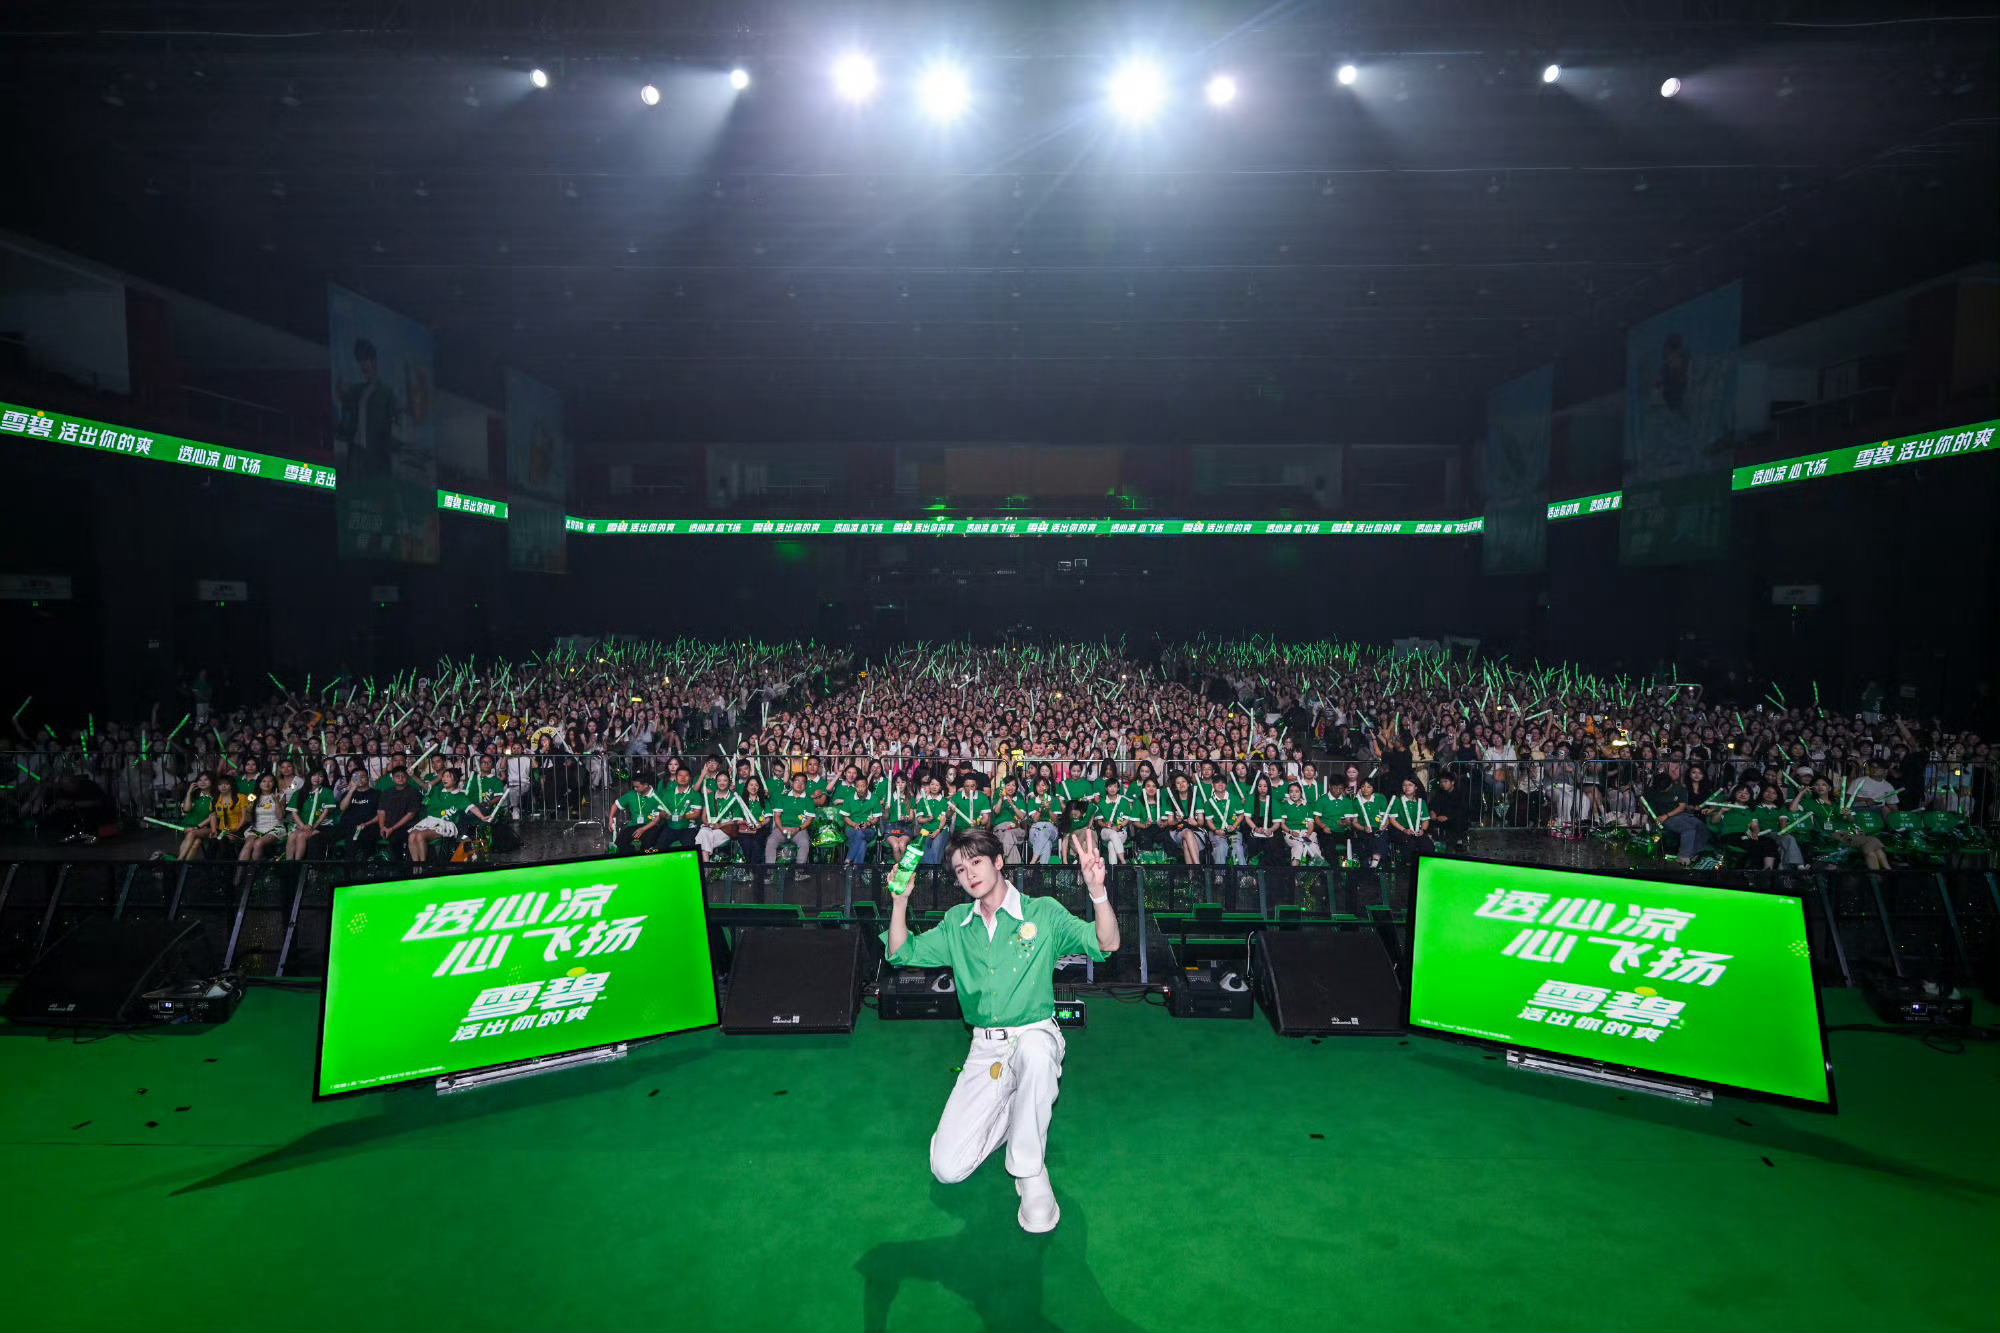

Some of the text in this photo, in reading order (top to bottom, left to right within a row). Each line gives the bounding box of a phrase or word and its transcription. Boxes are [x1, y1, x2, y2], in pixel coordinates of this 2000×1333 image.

[0, 411, 153, 454] 雪碧 活出你的爽
[1853, 428, 1995, 468] 雪碧 活出你的爽
[178, 446, 260, 474] 透心凉 心飞扬
[284, 465, 335, 486] 雪碧 活出
[1751, 458, 1828, 485] 透心凉 心飞扬
[401, 884, 618, 942] 透心凉
[1474, 887, 1695, 942] 透心凉
[432, 915, 648, 977] 心飞扬
[1502, 929, 1734, 987] 心飞扬
[462, 971, 611, 1022] 雪碧
[1527, 979, 1686, 1027] 雪碧
[450, 1005, 592, 1042] 活出你的爽
[1517, 1006, 1664, 1042] 活出你的爽
